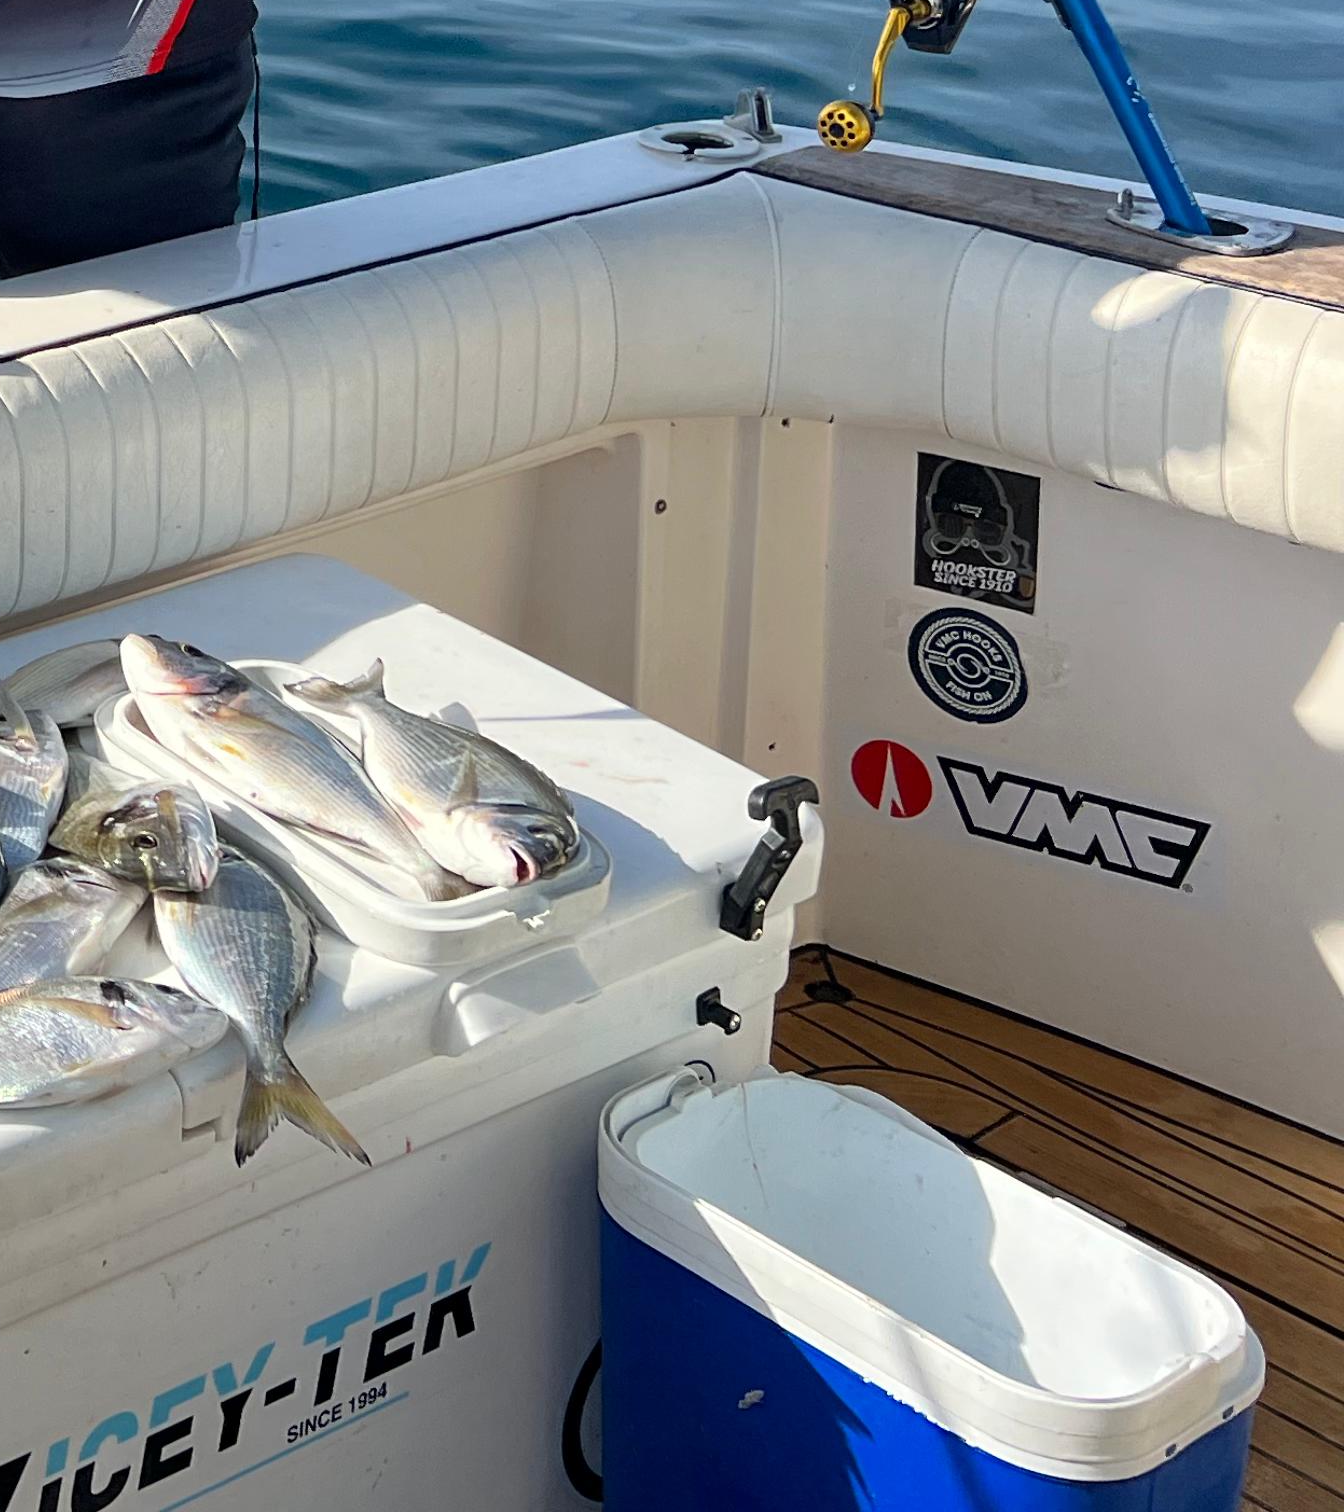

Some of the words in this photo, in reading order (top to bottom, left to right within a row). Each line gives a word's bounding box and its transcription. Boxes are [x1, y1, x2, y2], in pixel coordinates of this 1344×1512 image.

[931, 559, 1016, 583] HOOKSTER
[934, 572, 976, 588] SINCE
[979, 579, 1013, 593] 1910
[935, 631, 960, 648] VMC
[963, 630, 1003, 662] HOOKS
[945, 681, 971, 700] FISH
[974, 690, 993, 702] ON
[936, 755, 1211, 889] VMC
[37, 1241, 493, 1512] ICEY-TEK
[287, 1402, 343, 1443] SINCE
[348, 1381, 388, 1413] 1994
